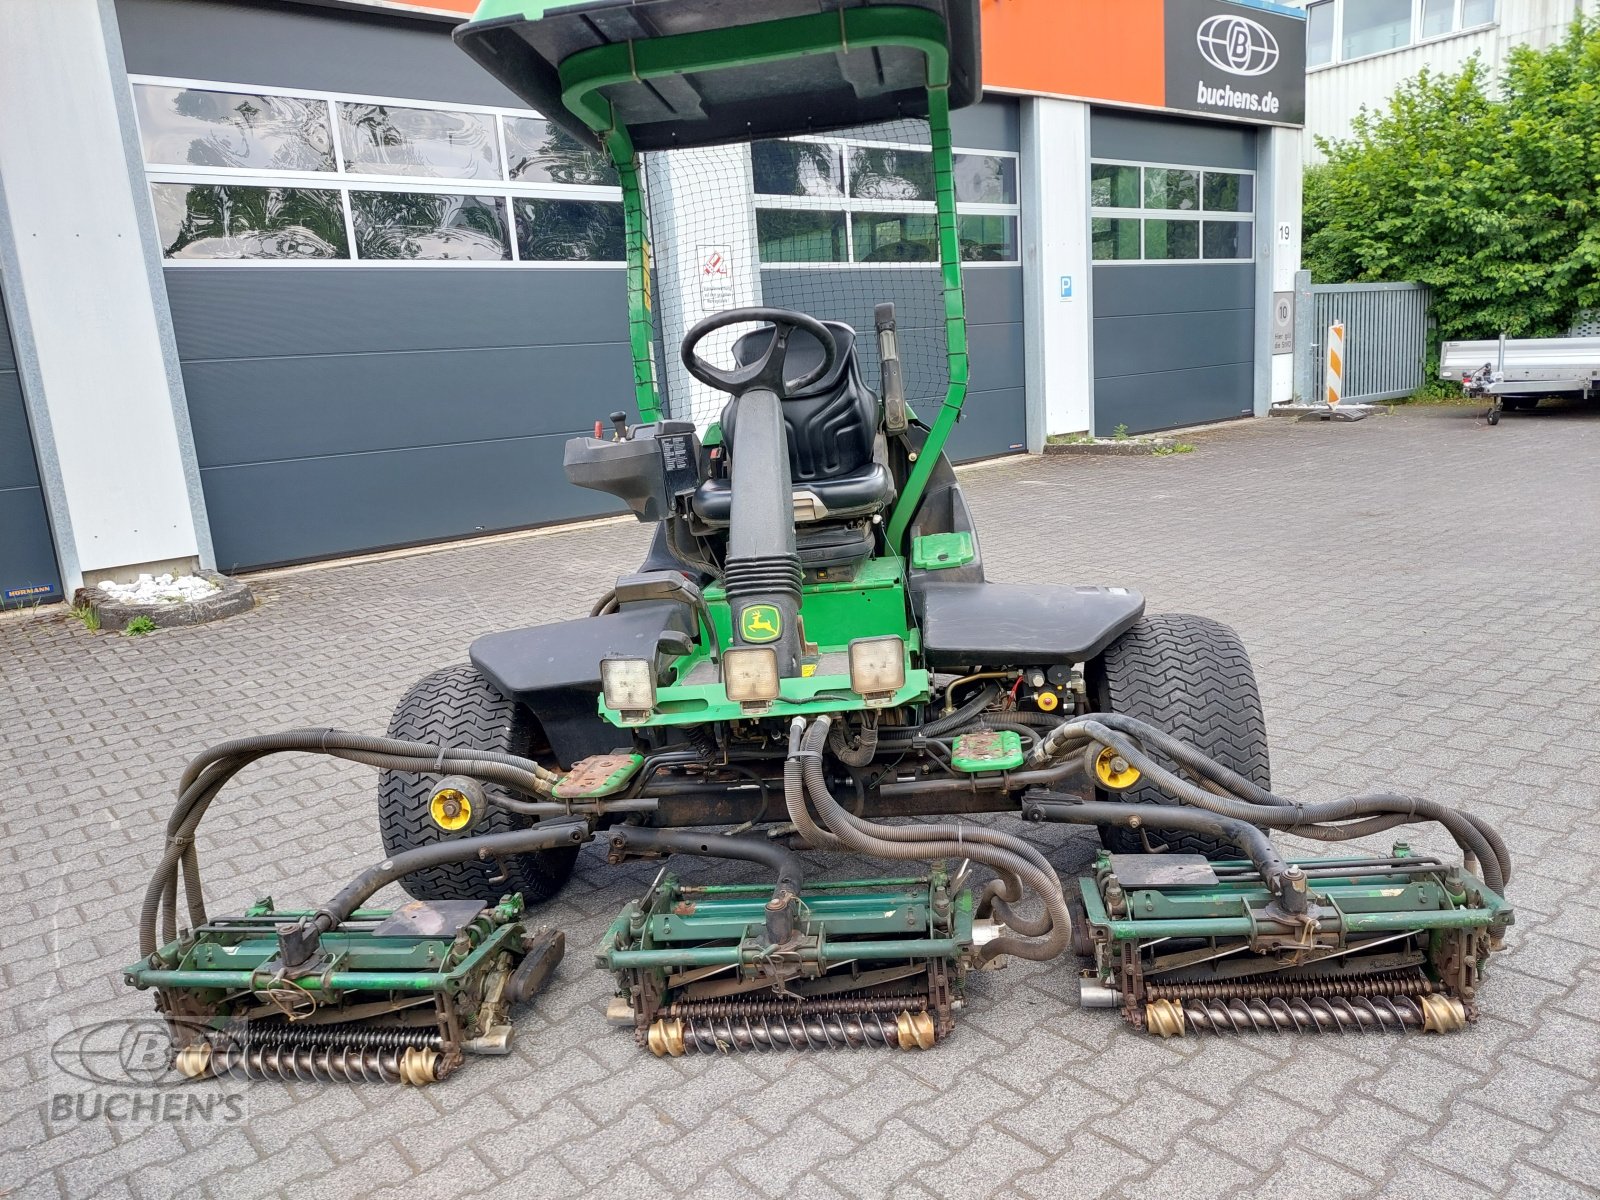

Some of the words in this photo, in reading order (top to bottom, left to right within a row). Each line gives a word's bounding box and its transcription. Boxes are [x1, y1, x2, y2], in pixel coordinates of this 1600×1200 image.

[1229, 26, 1249, 62] B
[1197, 80, 1279, 113] buchens.de
[1279, 225, 1290, 240] 19
[1062, 278, 1071, 295] P
[1279, 306, 1288, 319] 10
